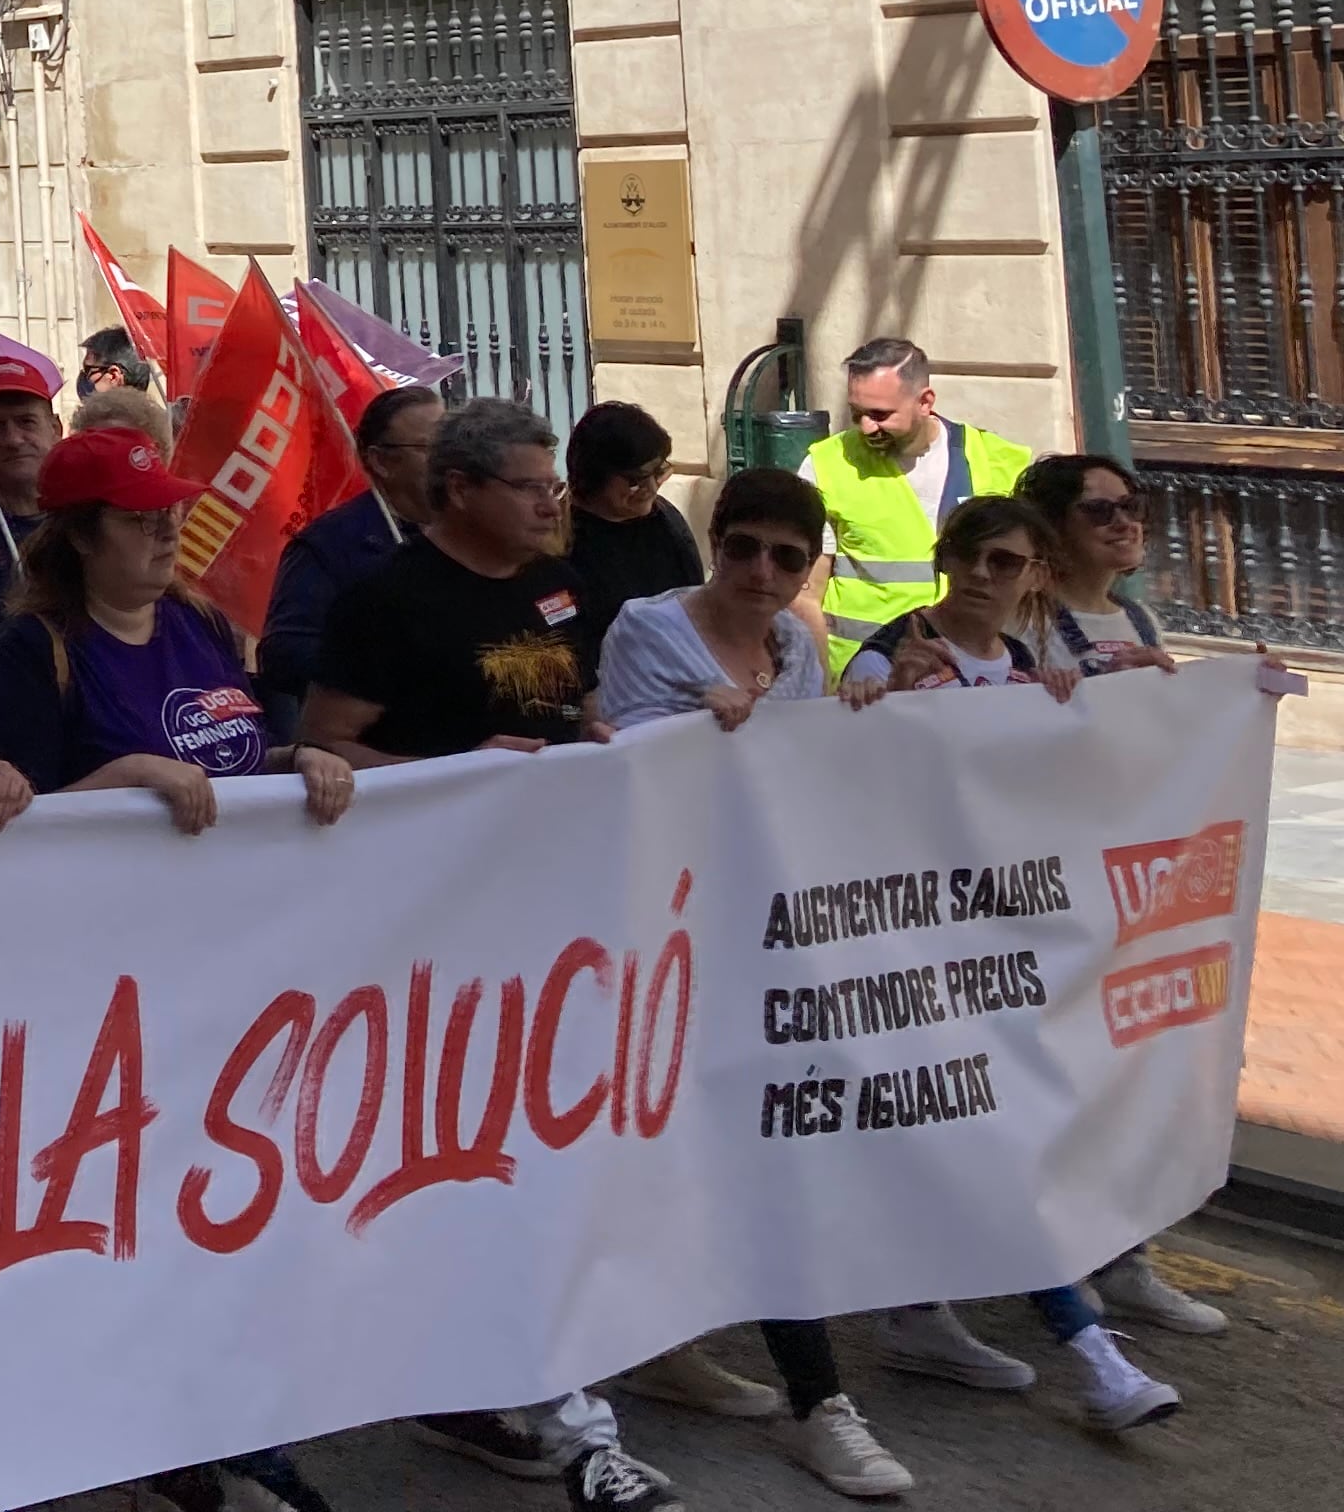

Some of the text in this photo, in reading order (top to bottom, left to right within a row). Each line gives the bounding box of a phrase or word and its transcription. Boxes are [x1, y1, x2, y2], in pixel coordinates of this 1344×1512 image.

[172, 717, 255, 753] FEMINISTA
[196, 690, 235, 710] UGT
[762, 855, 1071, 949] AUGMENTAR SALARIS
[763, 950, 1048, 1045] CONTINDRE PREUS
[176, 867, 694, 1254] SOLUCIÓ
[759, 1052, 998, 1138] MÉS IGUALTAT
